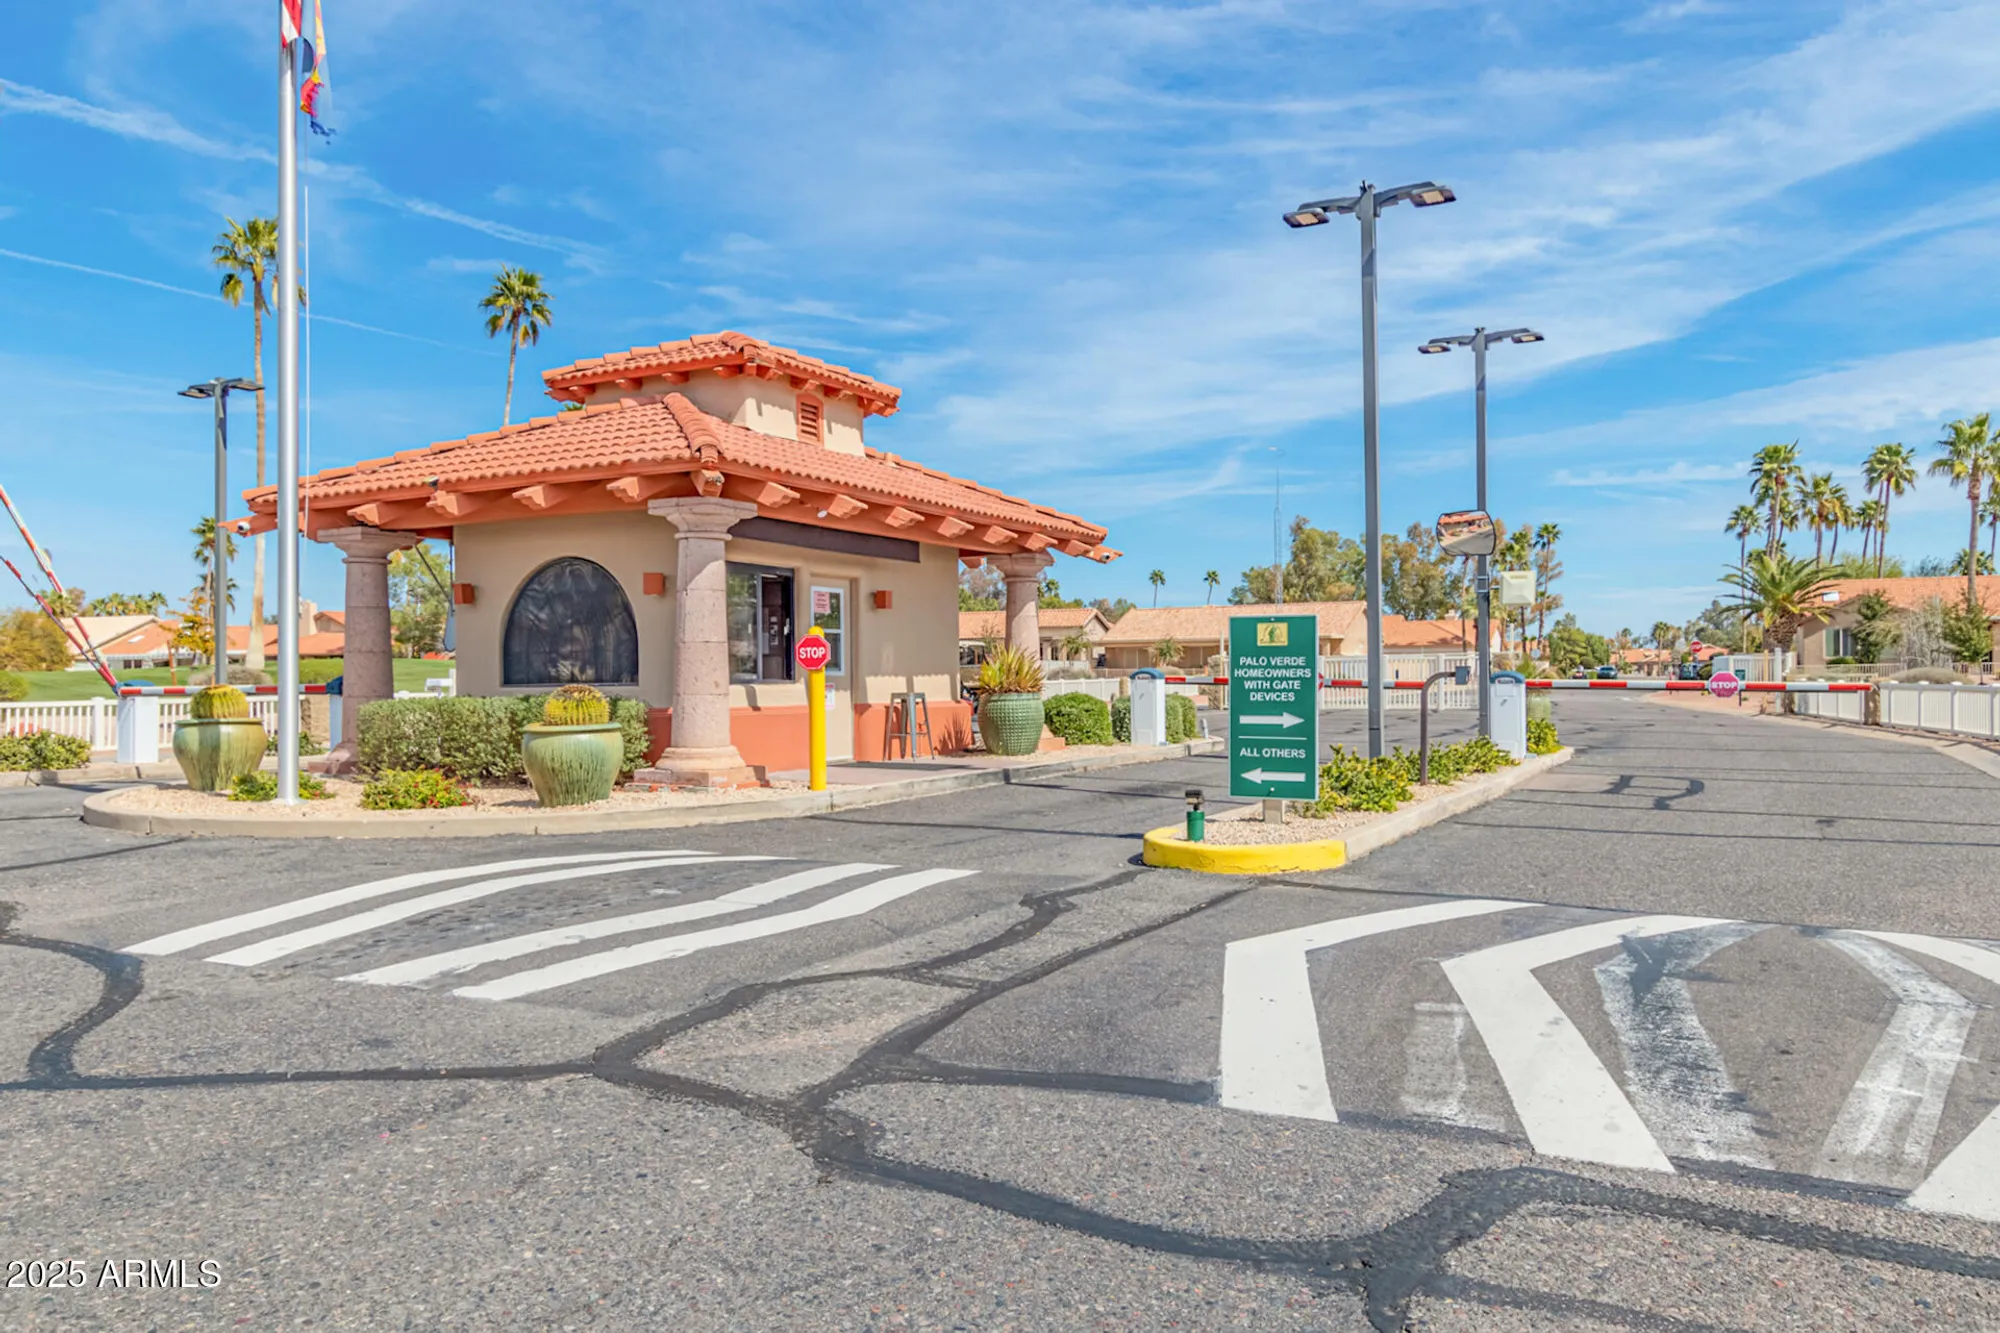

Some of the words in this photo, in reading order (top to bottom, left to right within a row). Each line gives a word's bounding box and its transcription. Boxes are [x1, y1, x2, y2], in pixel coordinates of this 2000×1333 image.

[800, 647, 825, 659] STOP
[1240, 656, 1267, 666] PALO
[1270, 656, 1306, 666] VERDE
[1234, 668, 1312, 678] HOMEOWNERS
[1244, 680, 1270, 690] WITH
[1273, 680, 1301, 690] GATE
[1250, 692, 1295, 701] DEVICES
[1240, 748, 1260, 757] ALL
[1262, 748, 1306, 758] OTHERS
